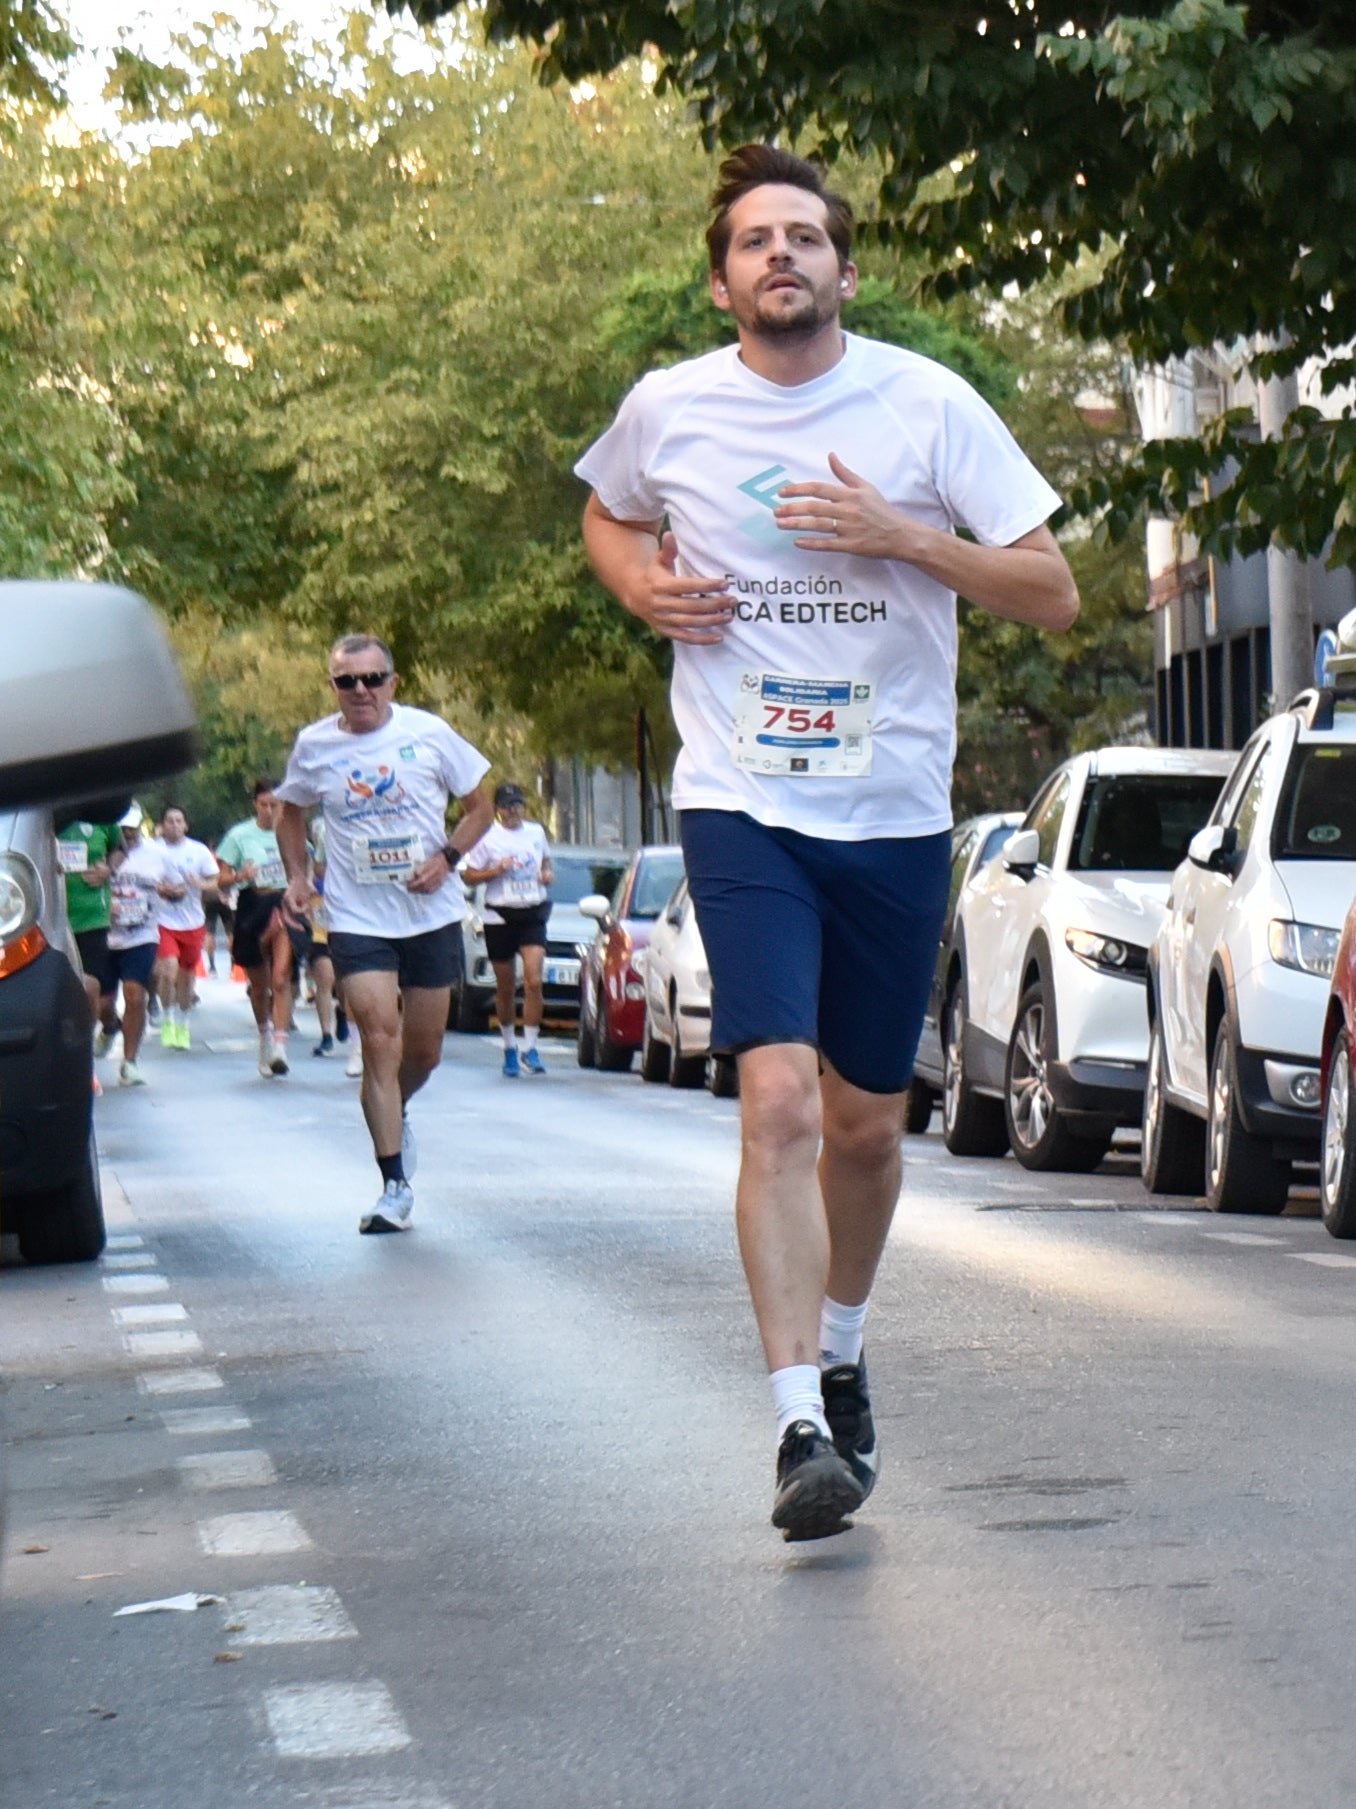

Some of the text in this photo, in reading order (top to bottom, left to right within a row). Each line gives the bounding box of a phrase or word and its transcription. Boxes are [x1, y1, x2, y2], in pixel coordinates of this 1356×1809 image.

[725, 574, 842, 595] Fundación
[780, 600, 887, 624] EDTECH
[763, 705, 835, 733] 754
[369, 850, 410, 865] 1011
